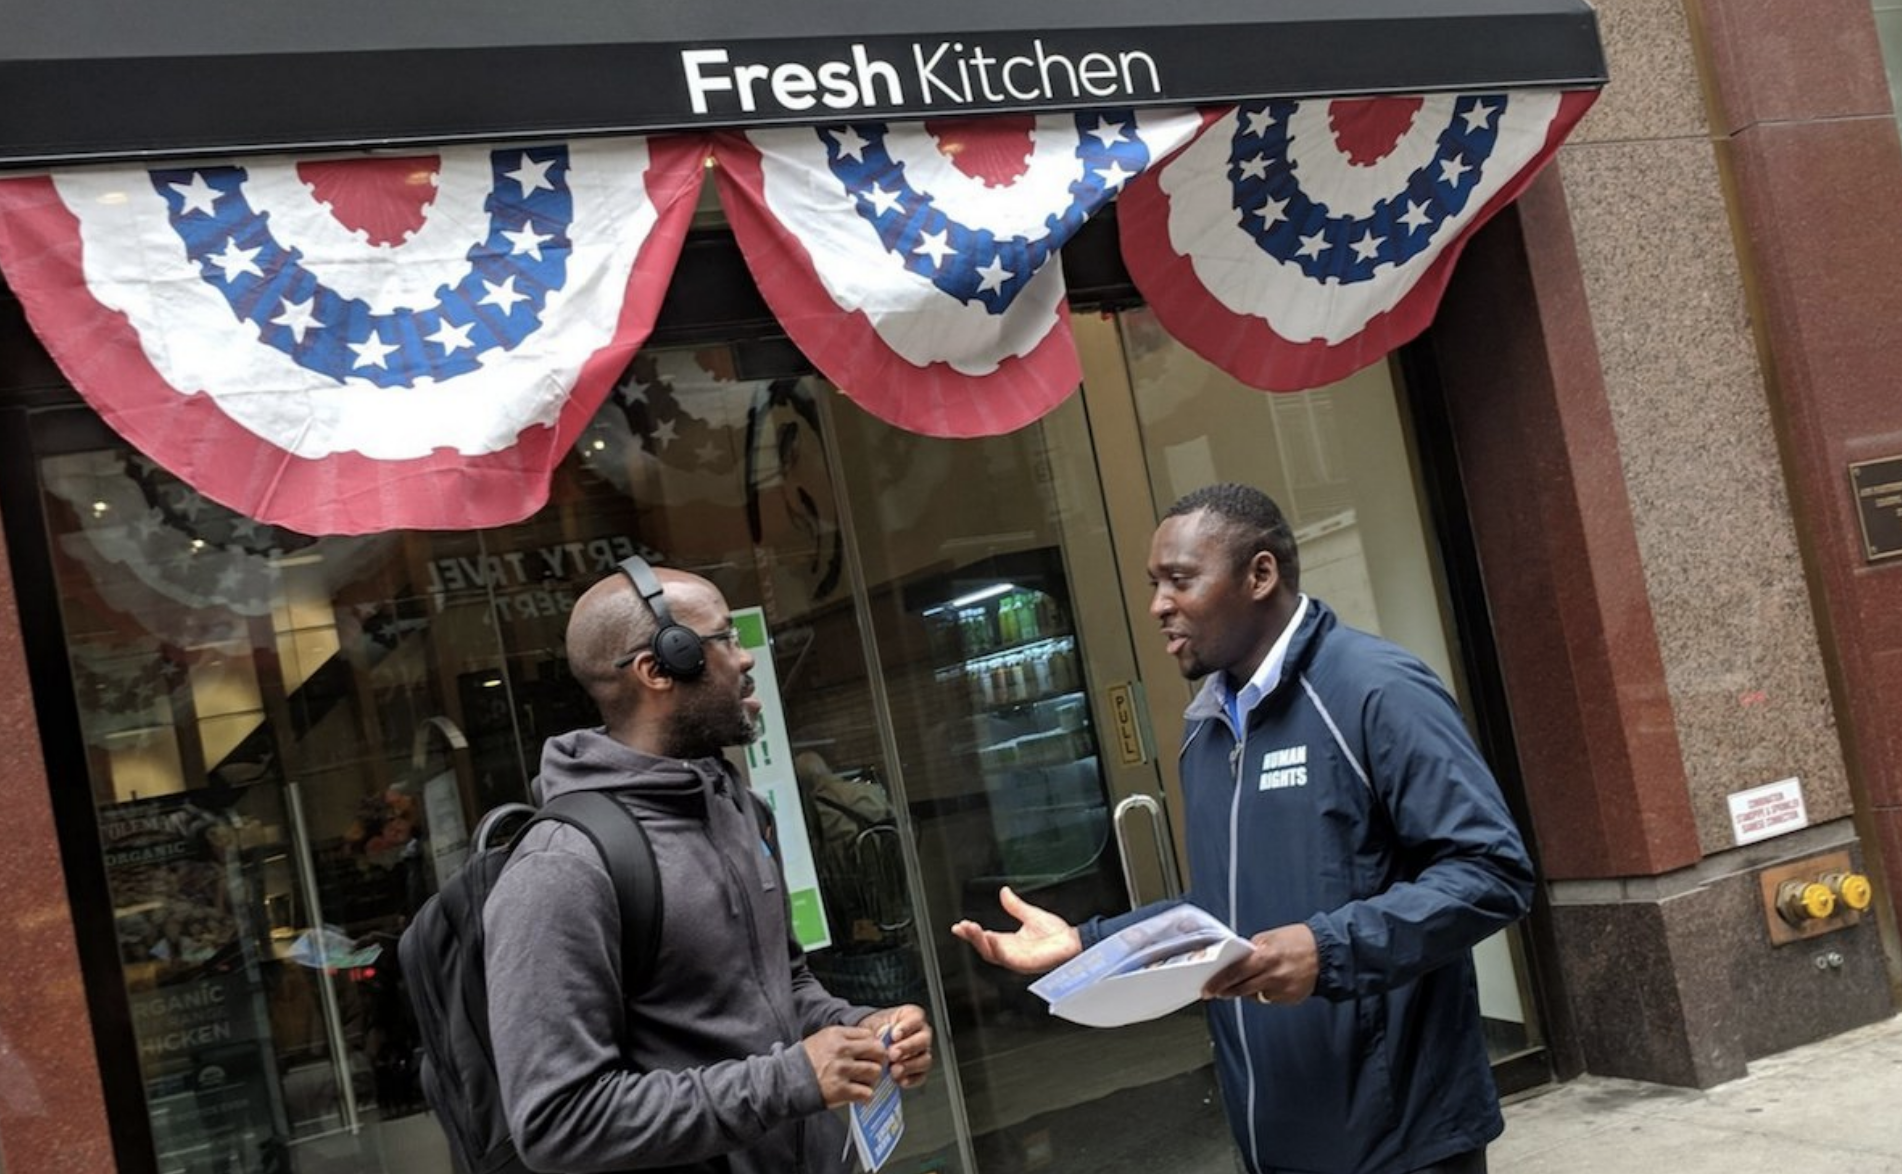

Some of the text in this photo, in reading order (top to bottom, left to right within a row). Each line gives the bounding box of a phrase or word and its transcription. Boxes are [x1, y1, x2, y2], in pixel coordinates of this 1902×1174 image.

[680, 39, 1162, 114] Fresh Kitchen
[1115, 695, 1135, 754] PULL
[1262, 745, 1307, 771] HUMAN
[1259, 766, 1308, 791] RIGHTS
[133, 984, 225, 1019] RGANIC
[139, 1022, 231, 1055] HICKEN
